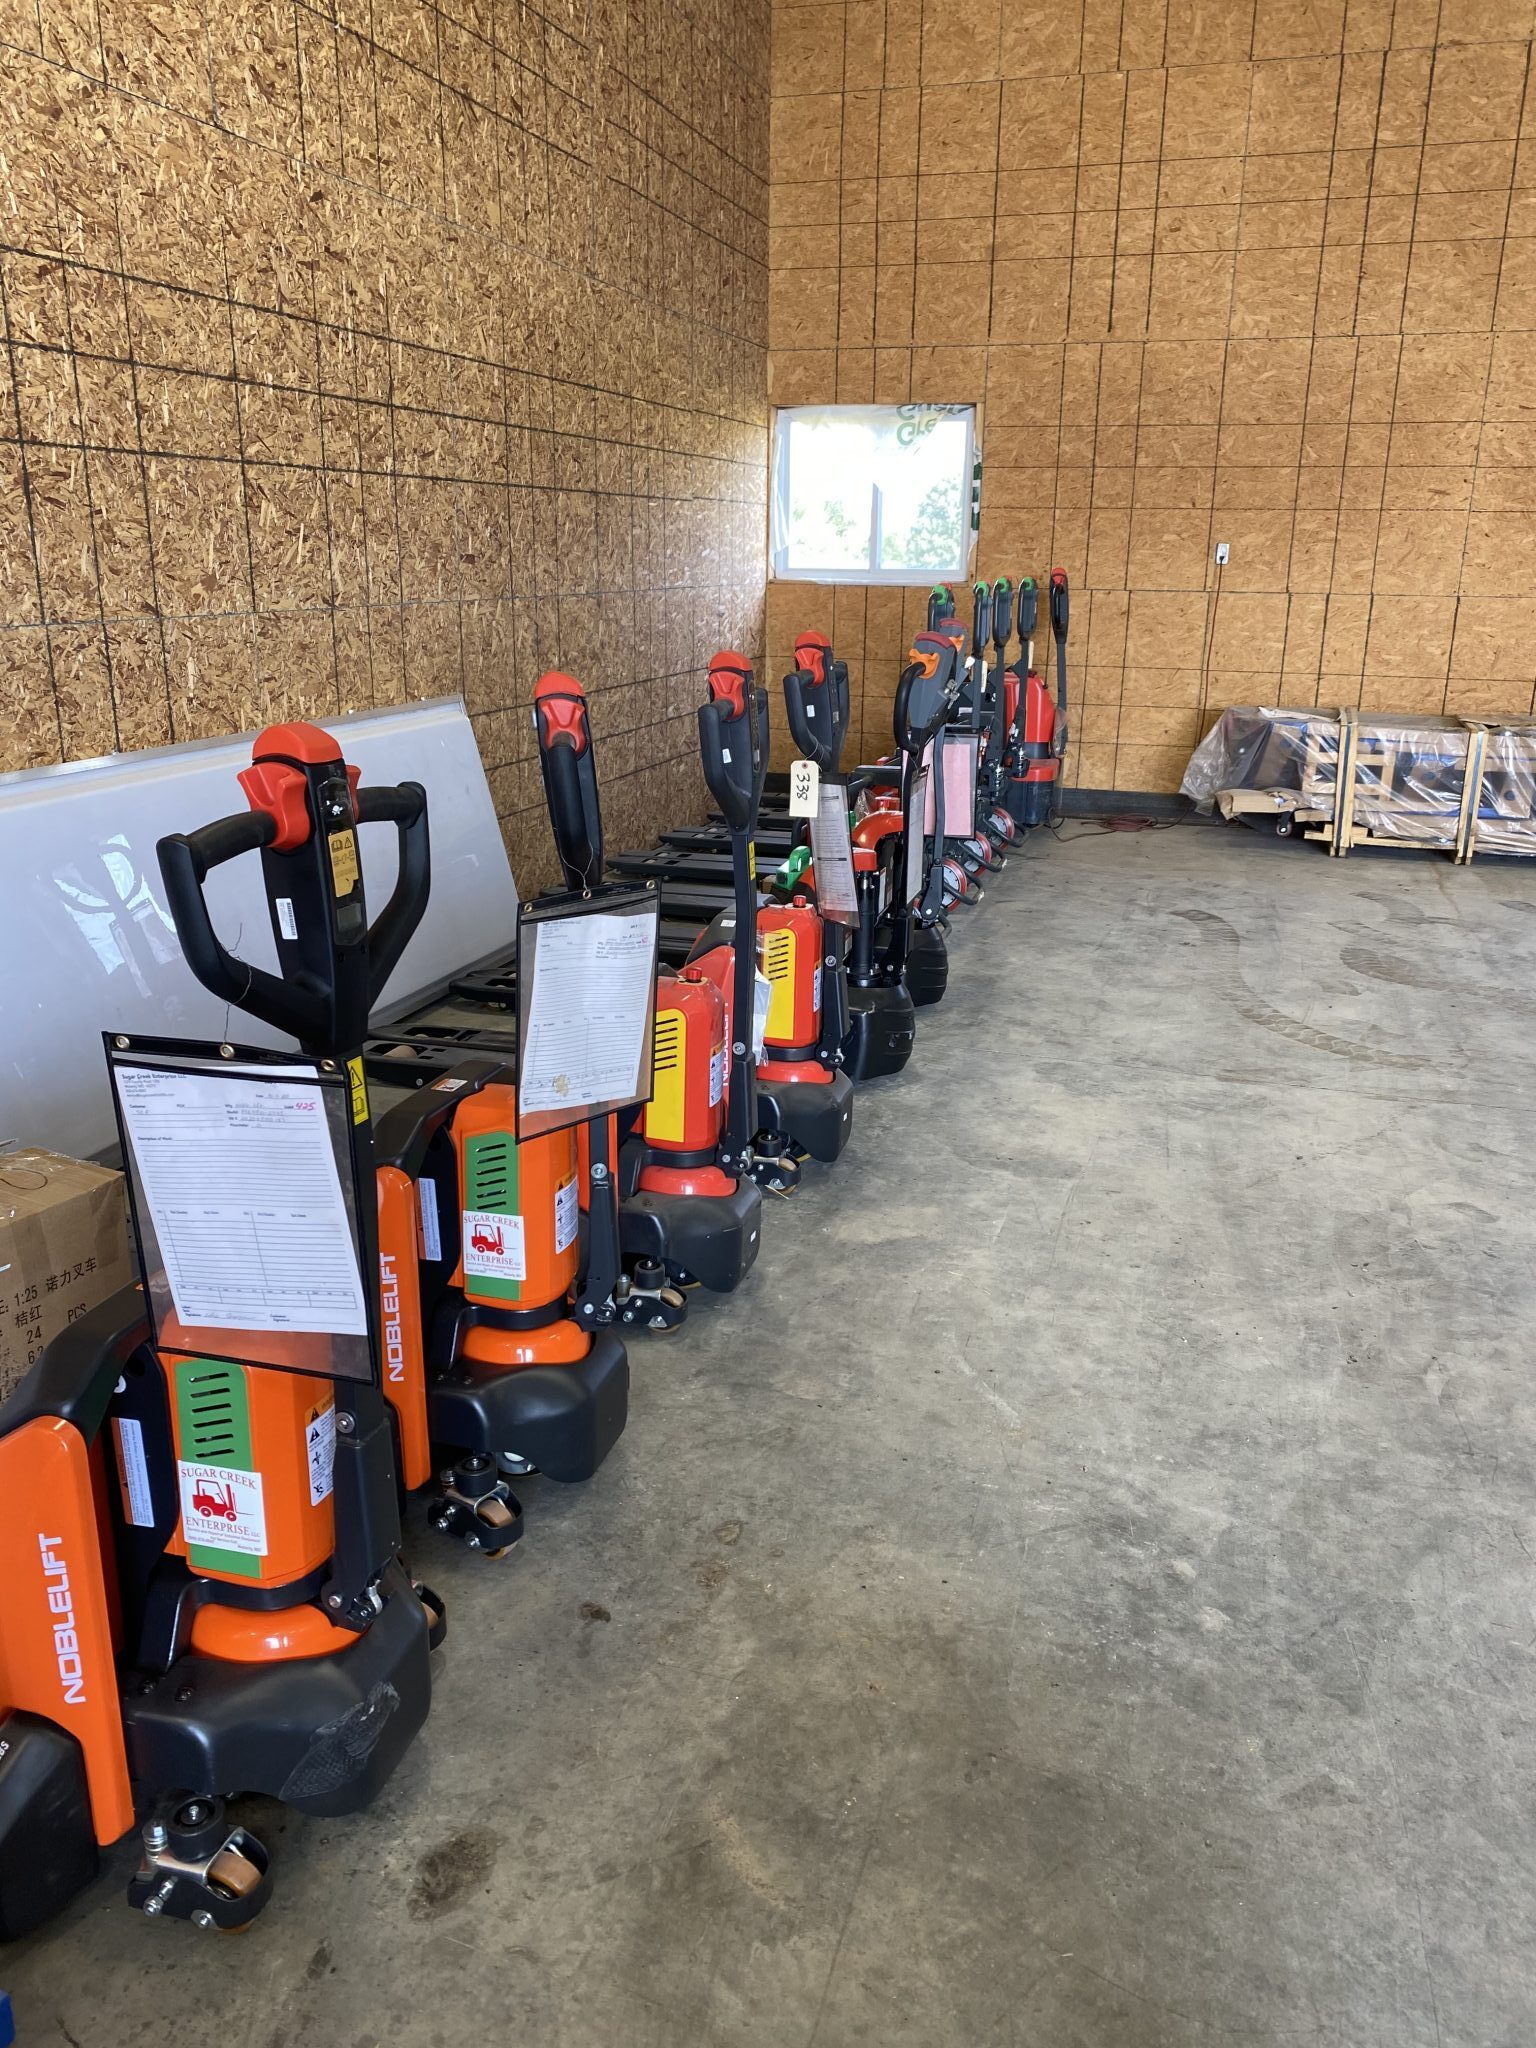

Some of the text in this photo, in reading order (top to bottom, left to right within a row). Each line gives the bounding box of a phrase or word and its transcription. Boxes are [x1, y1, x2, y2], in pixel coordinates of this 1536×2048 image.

[796, 772, 811, 801] 338
[295, 1102, 316, 1111] 425
[463, 1214, 520, 1230] SUGAR CREEK
[465, 1253, 514, 1266] ENTERPRISE
[45, 1257, 97, 1293] 诺力叉车
[379, 1252, 404, 1382] NOBLELIFT
[26, 1325, 42, 1344] 24
[181, 1467, 257, 1490] SUGAR CREEK
[185, 1516, 250, 1536] ENTERPRISE
[38, 1533, 87, 1704] NOBLELIFT
